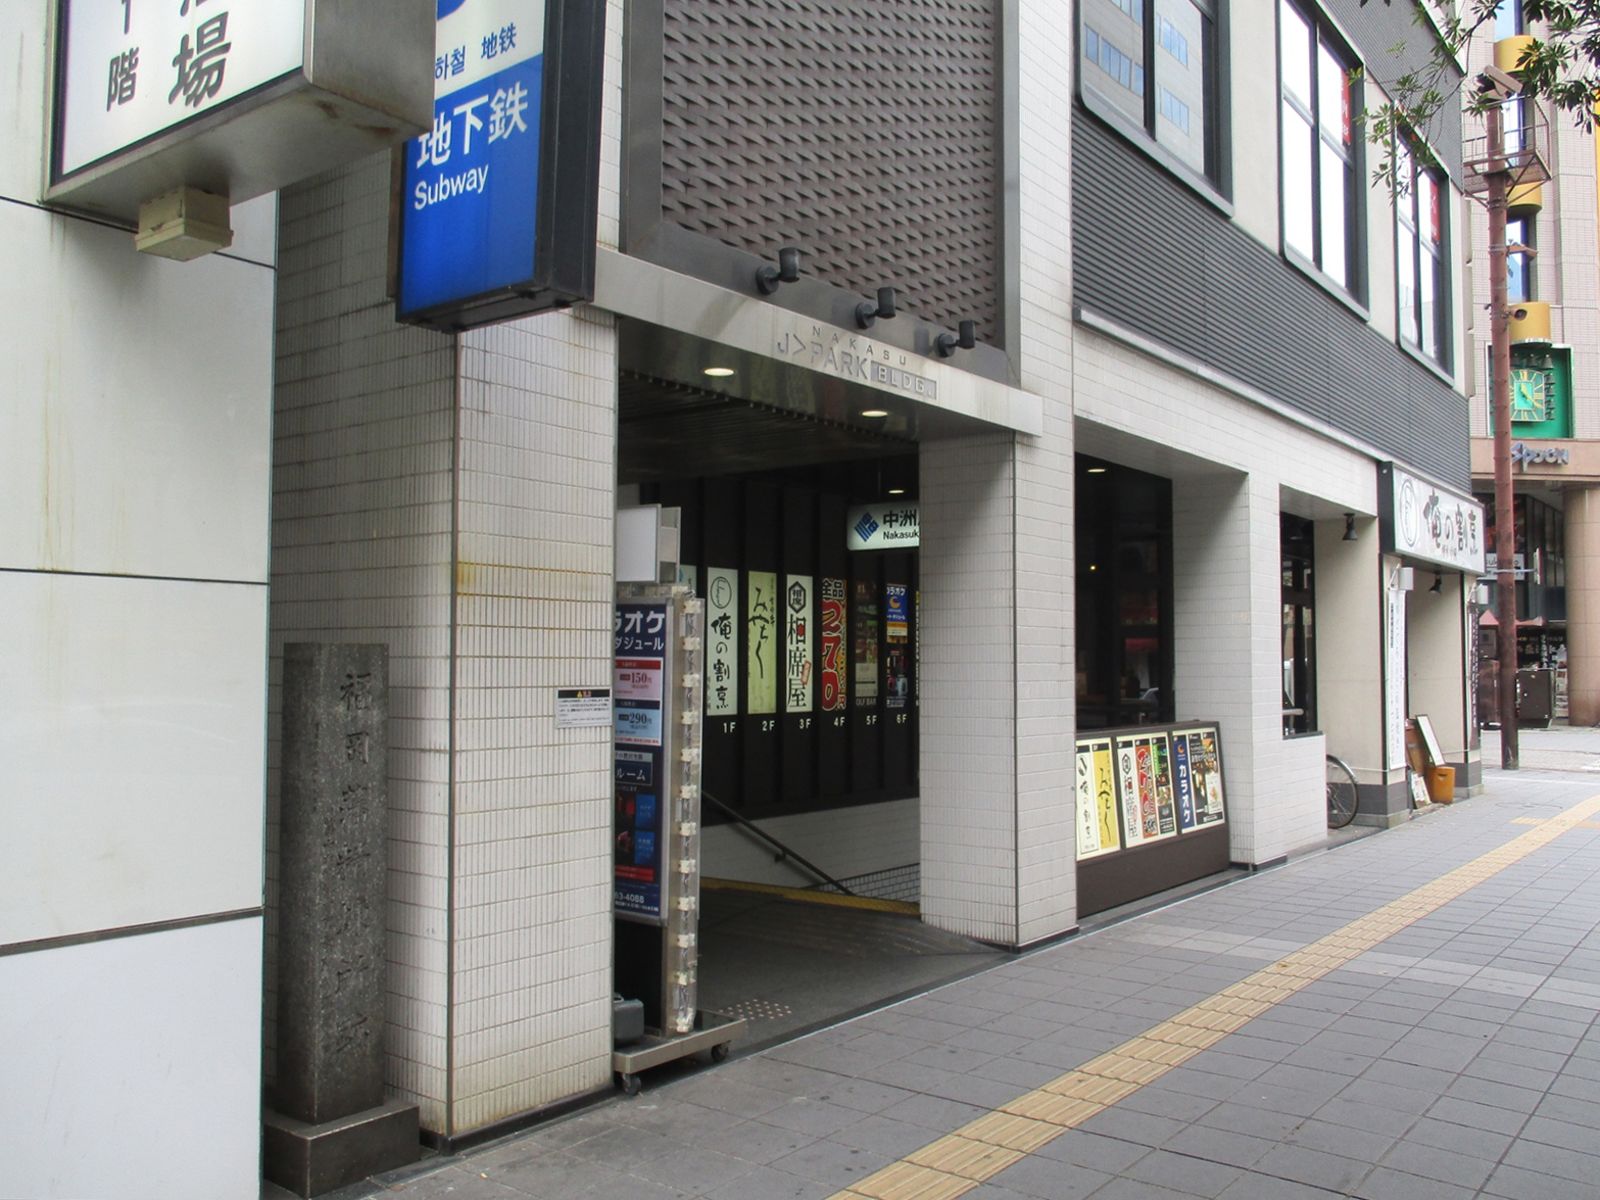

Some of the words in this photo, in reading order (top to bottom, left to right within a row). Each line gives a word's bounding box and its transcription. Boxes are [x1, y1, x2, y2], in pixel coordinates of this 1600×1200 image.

[168, 0, 232, 108] 場
[416, 81, 528, 170] 地下鉄
[414, 164, 489, 210] Subway
[812, 325, 907, 366] NAKASU
[883, 508, 920, 529] 中洲
[710, 612, 732, 710] 俺の割烹
[787, 613, 807, 708] 相席屋
[723, 721, 736, 733] 1F
[762, 720, 775, 731] 2F
[799, 718, 811, 729] 3F
[833, 717, 845, 727] 4F
[866, 715, 877, 726] 5F
[896, 714, 907, 724] 6F
[1179, 764, 1191, 823] カラオケ
